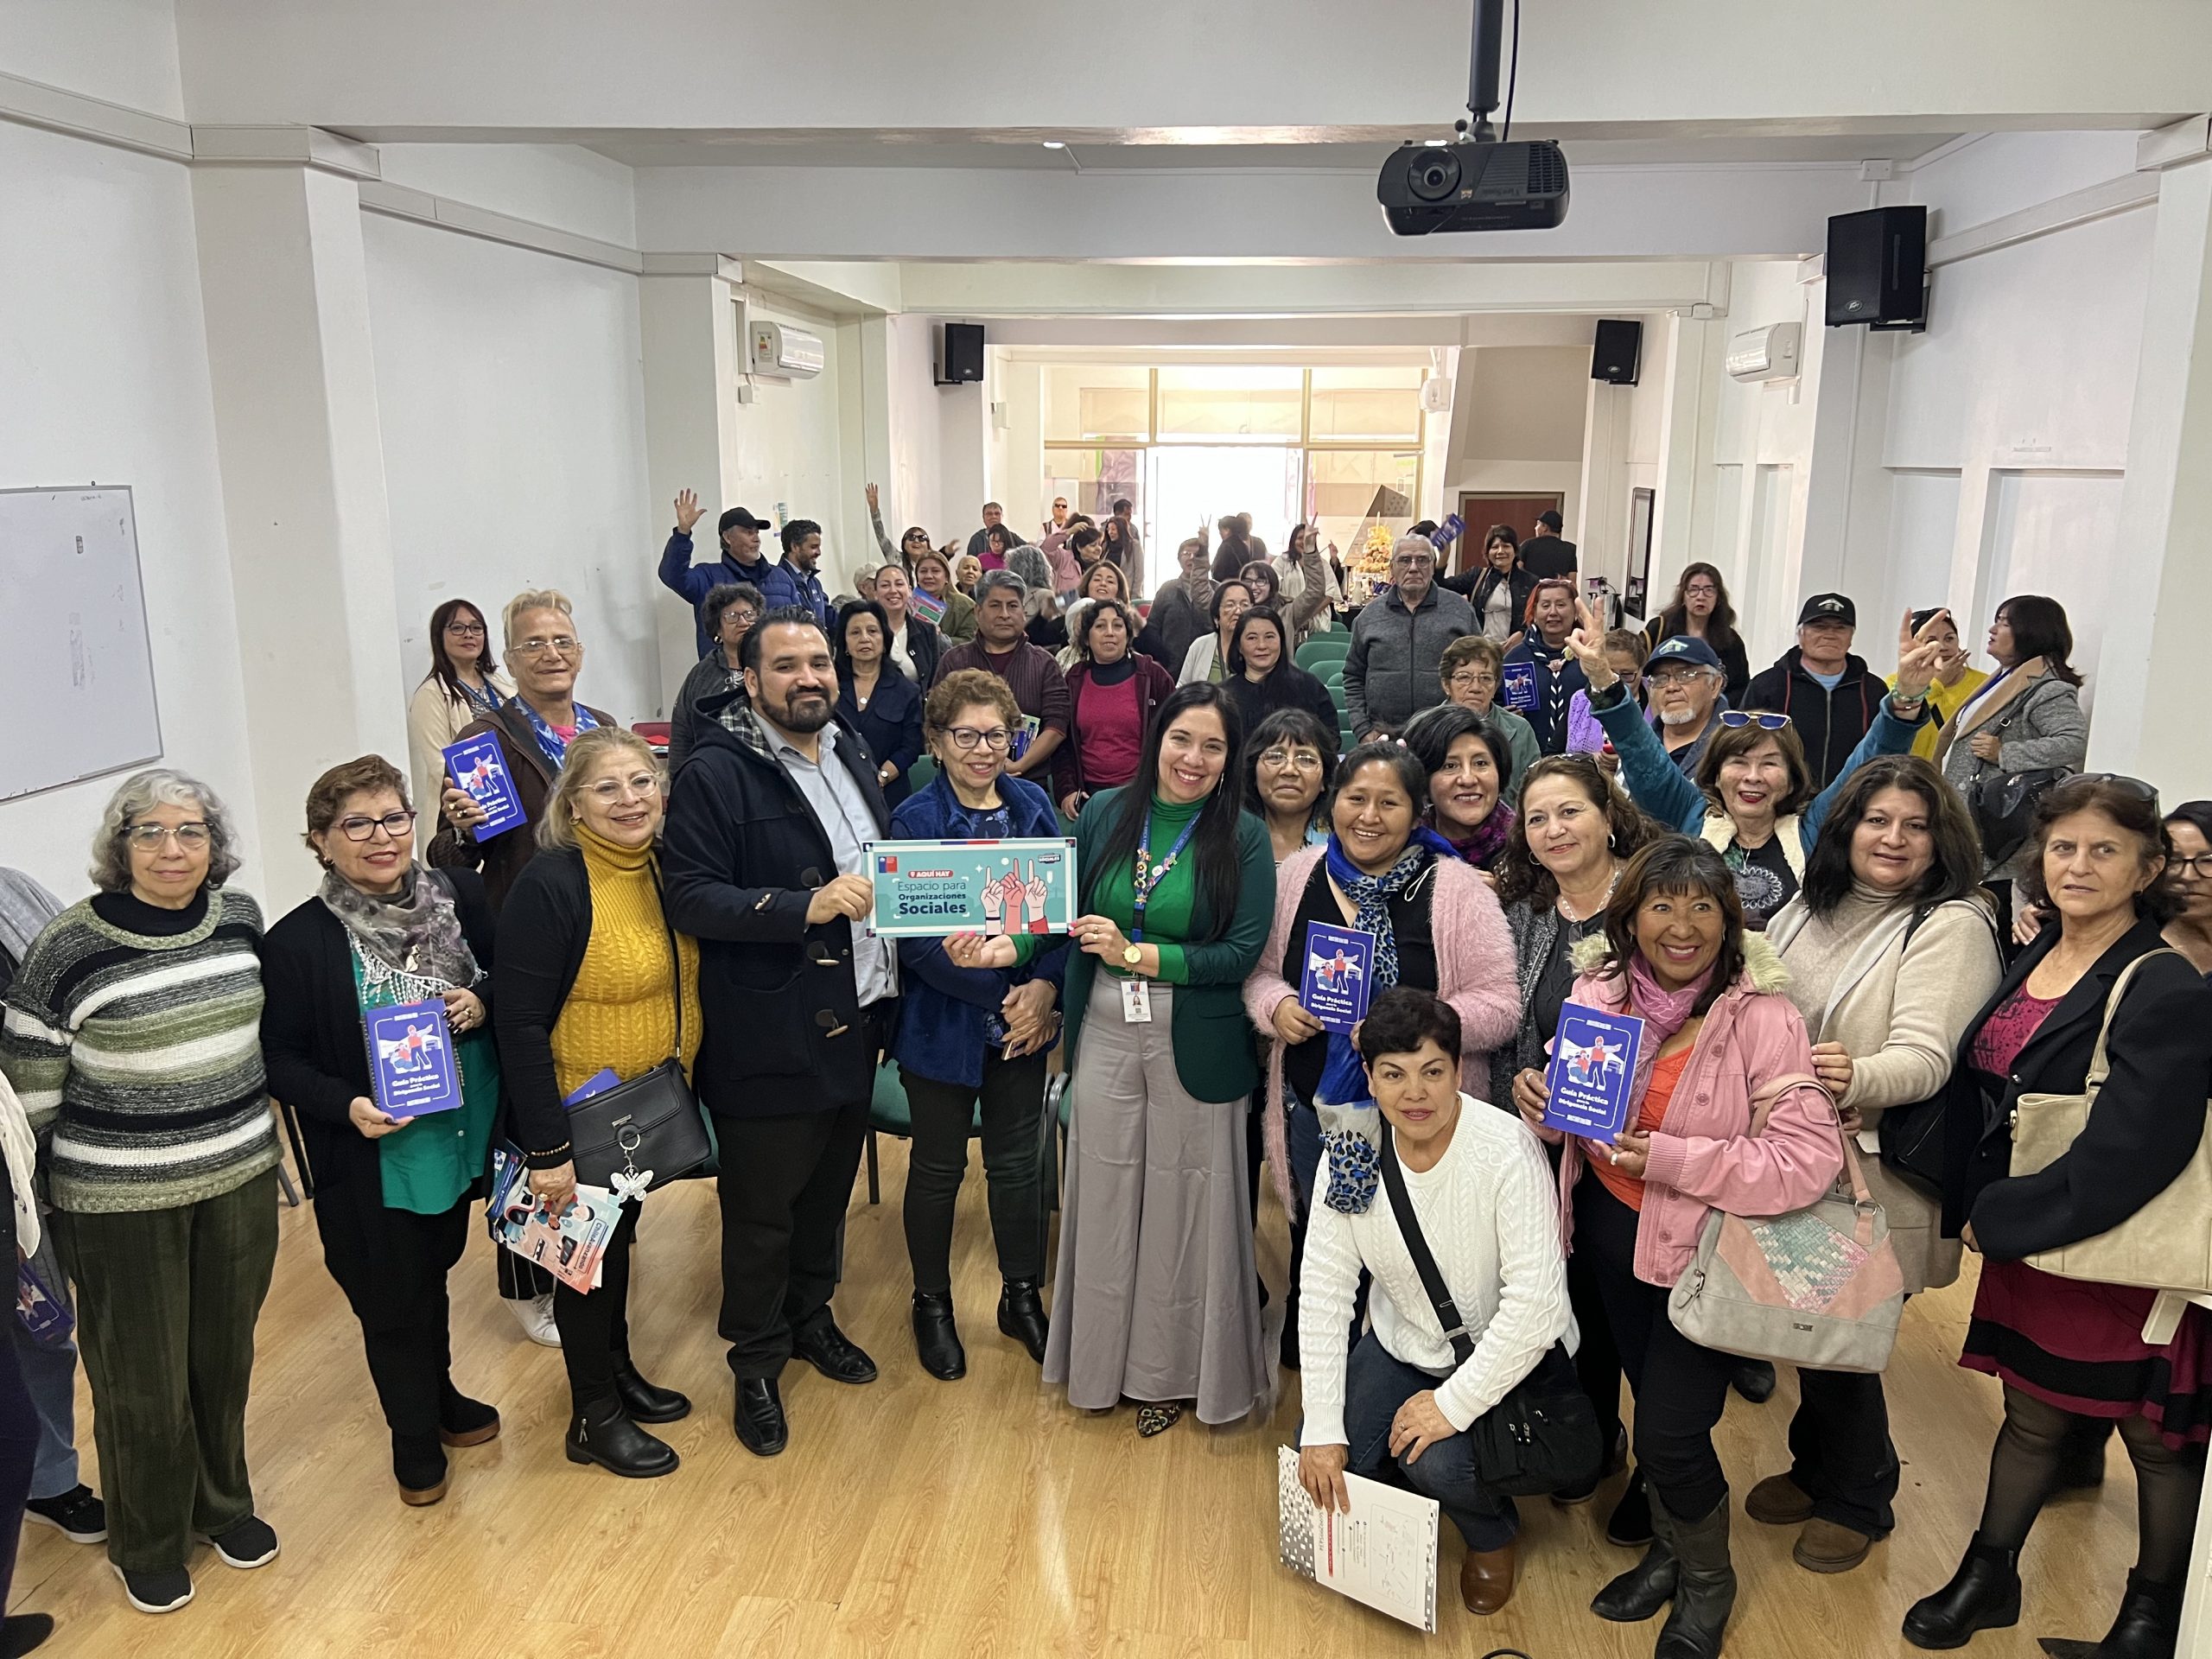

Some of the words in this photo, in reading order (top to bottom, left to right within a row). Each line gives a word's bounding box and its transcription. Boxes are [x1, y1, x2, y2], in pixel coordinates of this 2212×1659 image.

[898, 881, 939, 893] Espacio
[943, 881, 966, 892] para
[899, 893, 967, 901] Organizaciones
[899, 901, 967, 914] Sociales
[1326, 996, 1353, 1006] Práctica
[1560, 1086, 1578, 1097] Guía
[1578, 1090, 1609, 1105] Práctica
[578, 1222, 602, 1269] ChileAvanzando
